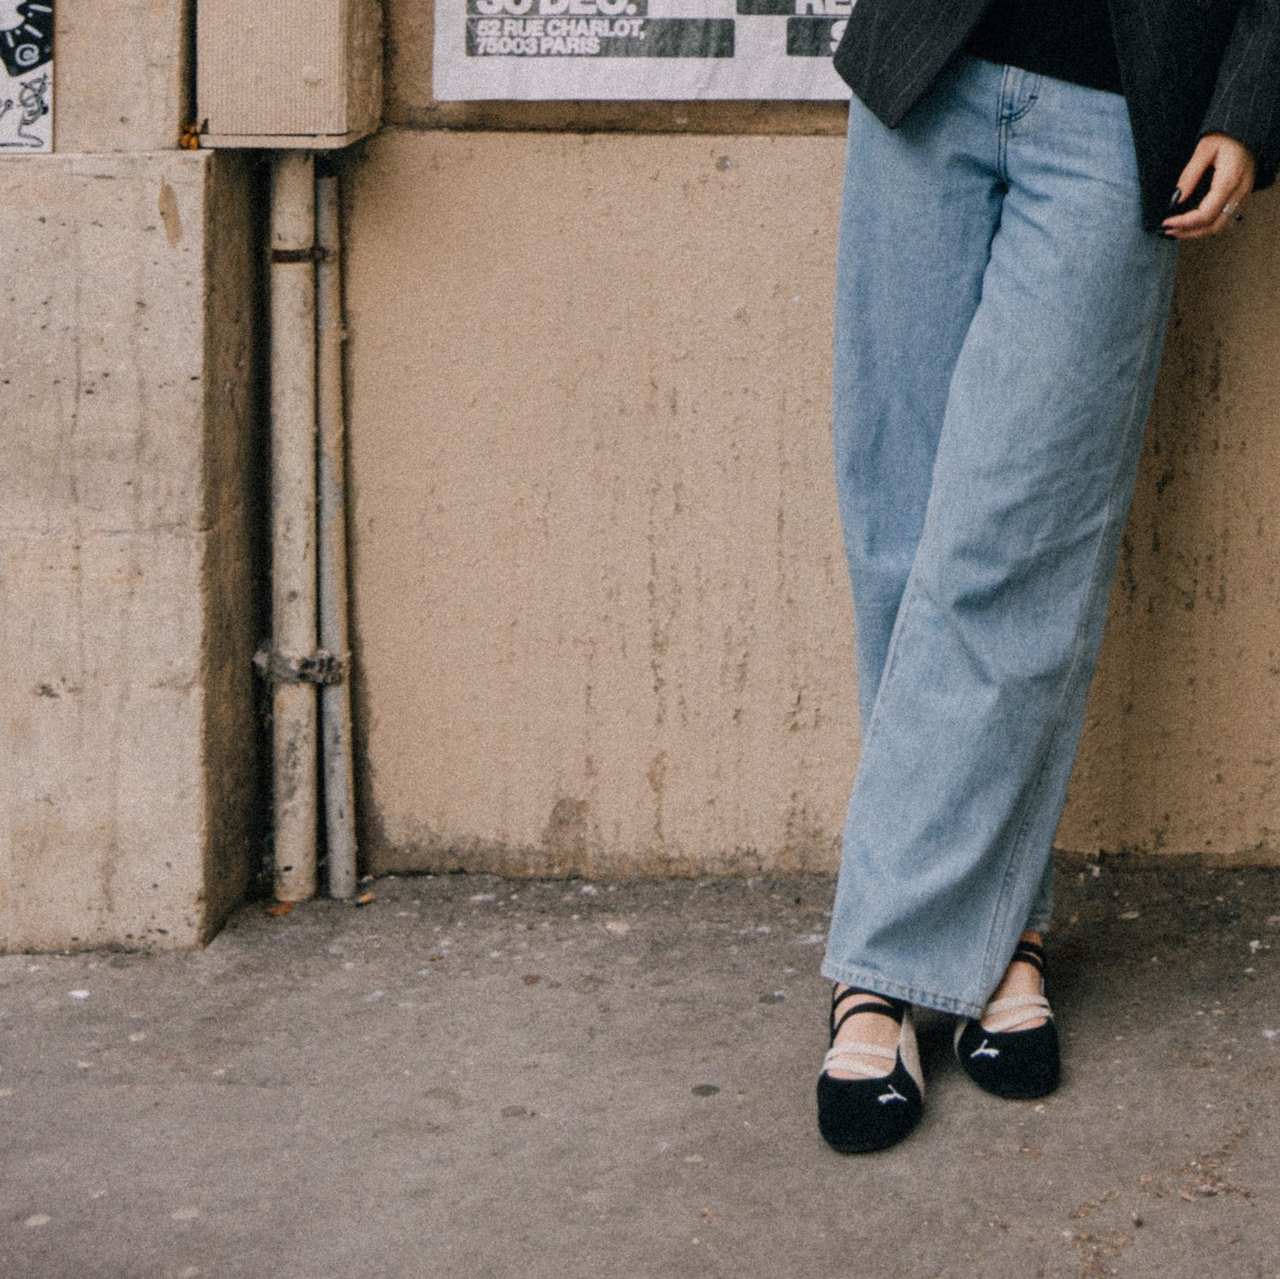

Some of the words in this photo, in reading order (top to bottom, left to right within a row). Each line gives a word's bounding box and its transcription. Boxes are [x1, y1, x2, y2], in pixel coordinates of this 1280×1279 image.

[476, 20, 502, 38] 52
[503, 20, 545, 38] RUE
[547, 19, 646, 40] CHARLOT,
[476, 37, 539, 55] 75003
[539, 37, 601, 55] PARIS
